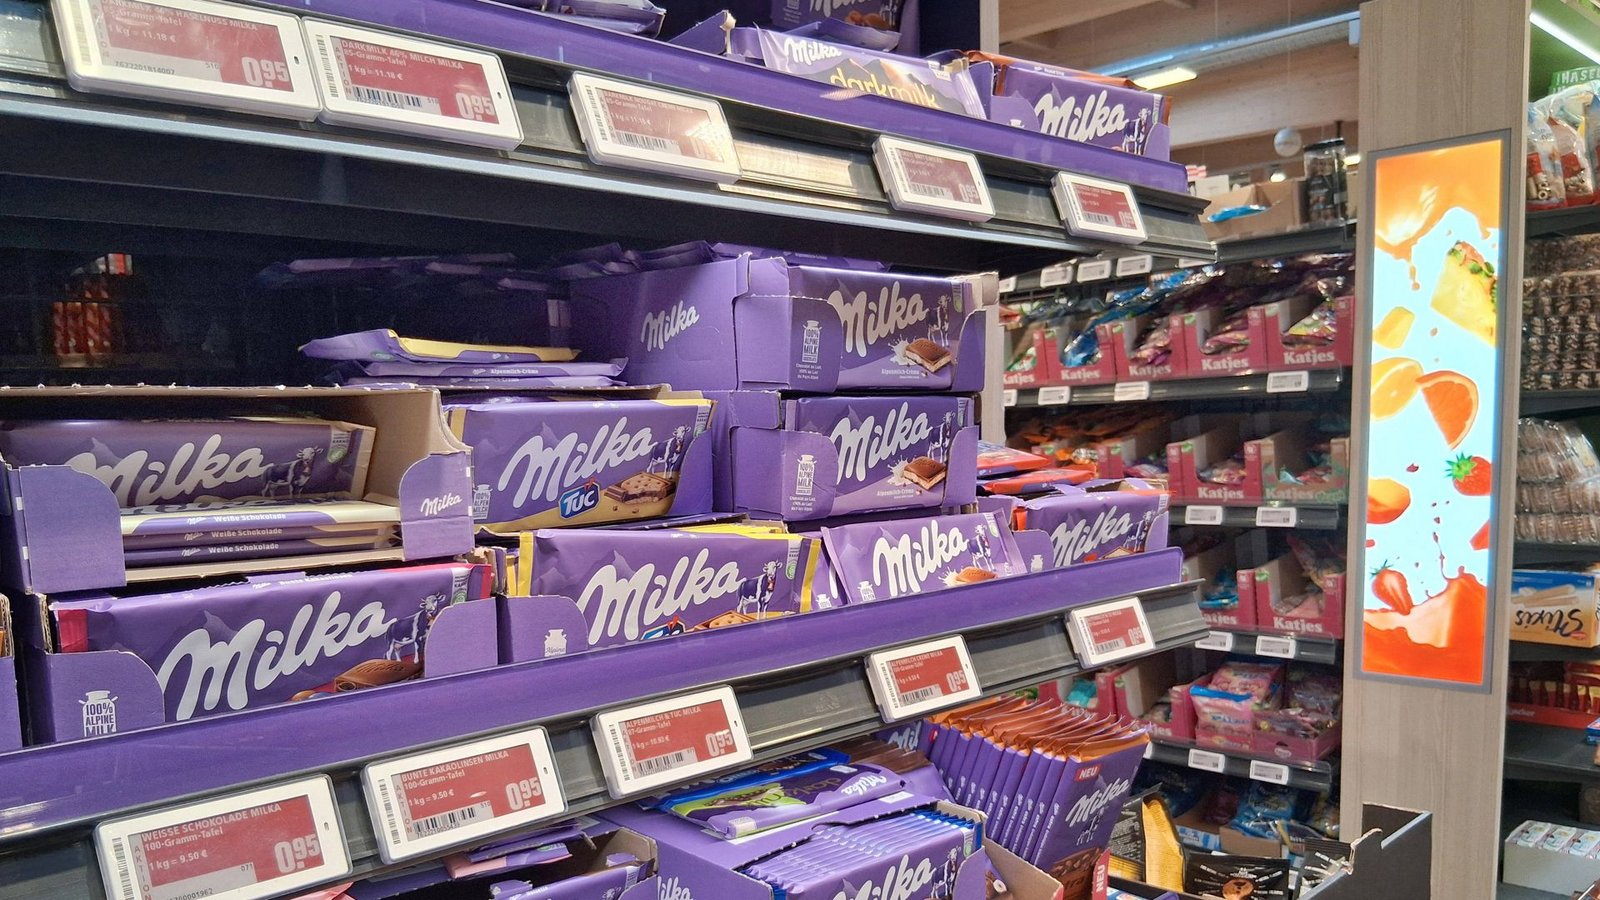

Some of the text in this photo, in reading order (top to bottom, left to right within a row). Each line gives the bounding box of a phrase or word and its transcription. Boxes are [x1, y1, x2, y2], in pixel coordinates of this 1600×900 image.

[229, 19, 258, 30] MILKA
[341, 40, 389, 57] DARKMILK
[409, 52, 436, 64] MILCH
[438, 58, 464, 70] MILKA
[784, 36, 843, 65] Milka
[241, 56, 290, 88] 0.95
[455, 92, 496, 121] 0.95
[1034, 90, 1130, 142] Milka
[641, 301, 700, 351] Milka
[828, 280, 931, 357] Milka
[1201, 356, 1249, 372] Katjes
[1284, 349, 1335, 365] Katjes
[830, 401, 933, 486] Milka
[65, 434, 274, 508] Milka
[498, 416, 659, 509] Milka
[420, 493, 463, 517] Milka
[563, 489, 595, 516] TUC
[1198, 487, 1244, 502] Katjes
[213, 513, 239, 522] Weiße
[241, 512, 286, 521] Schokolade
[211, 530, 236, 539] Weiße
[237, 528, 283, 537] Schokolade
[1051, 506, 1133, 568] Milka
[208, 545, 233, 554] Weiße
[234, 542, 279, 552] Schokolade
[873, 520, 968, 597] Milka
[576, 549, 747, 645] Milka
[1201, 611, 1238, 626] atjes
[1273, 616, 1322, 633] Katjes
[158, 591, 398, 721] Milka
[86, 702, 114, 716] 100%
[86, 714, 114, 726] ALPINE
[625, 714, 664, 729] ALPENMILCH
[682, 705, 702, 717] MILKA
[86, 724, 114, 736] MILK
[705, 729, 733, 757] 0.95
[888, 721, 922, 751] Mil
[401, 751, 509, 783] BUNTE KAKAOLINSEN MILKA
[404, 770, 466, 790] 100-Gramm-Tafel
[1079, 767, 1098, 778] NEU
[414, 796, 425, 808] kg
[432, 791, 448, 802] 9.50
[506, 777, 541, 811] 0.95
[841, 775, 887, 796] Milka
[1065, 778, 1129, 828] Milka
[142, 803, 282, 842] WEISSE SCHOKOLADE MILKA
[144, 827, 223, 852] 100-Gramm-Tafel
[273, 834, 320, 873] 0.95
[156, 859, 170, 871] kg
[180, 852, 200, 864] 9.50
[1096, 864, 1105, 893] NEU
